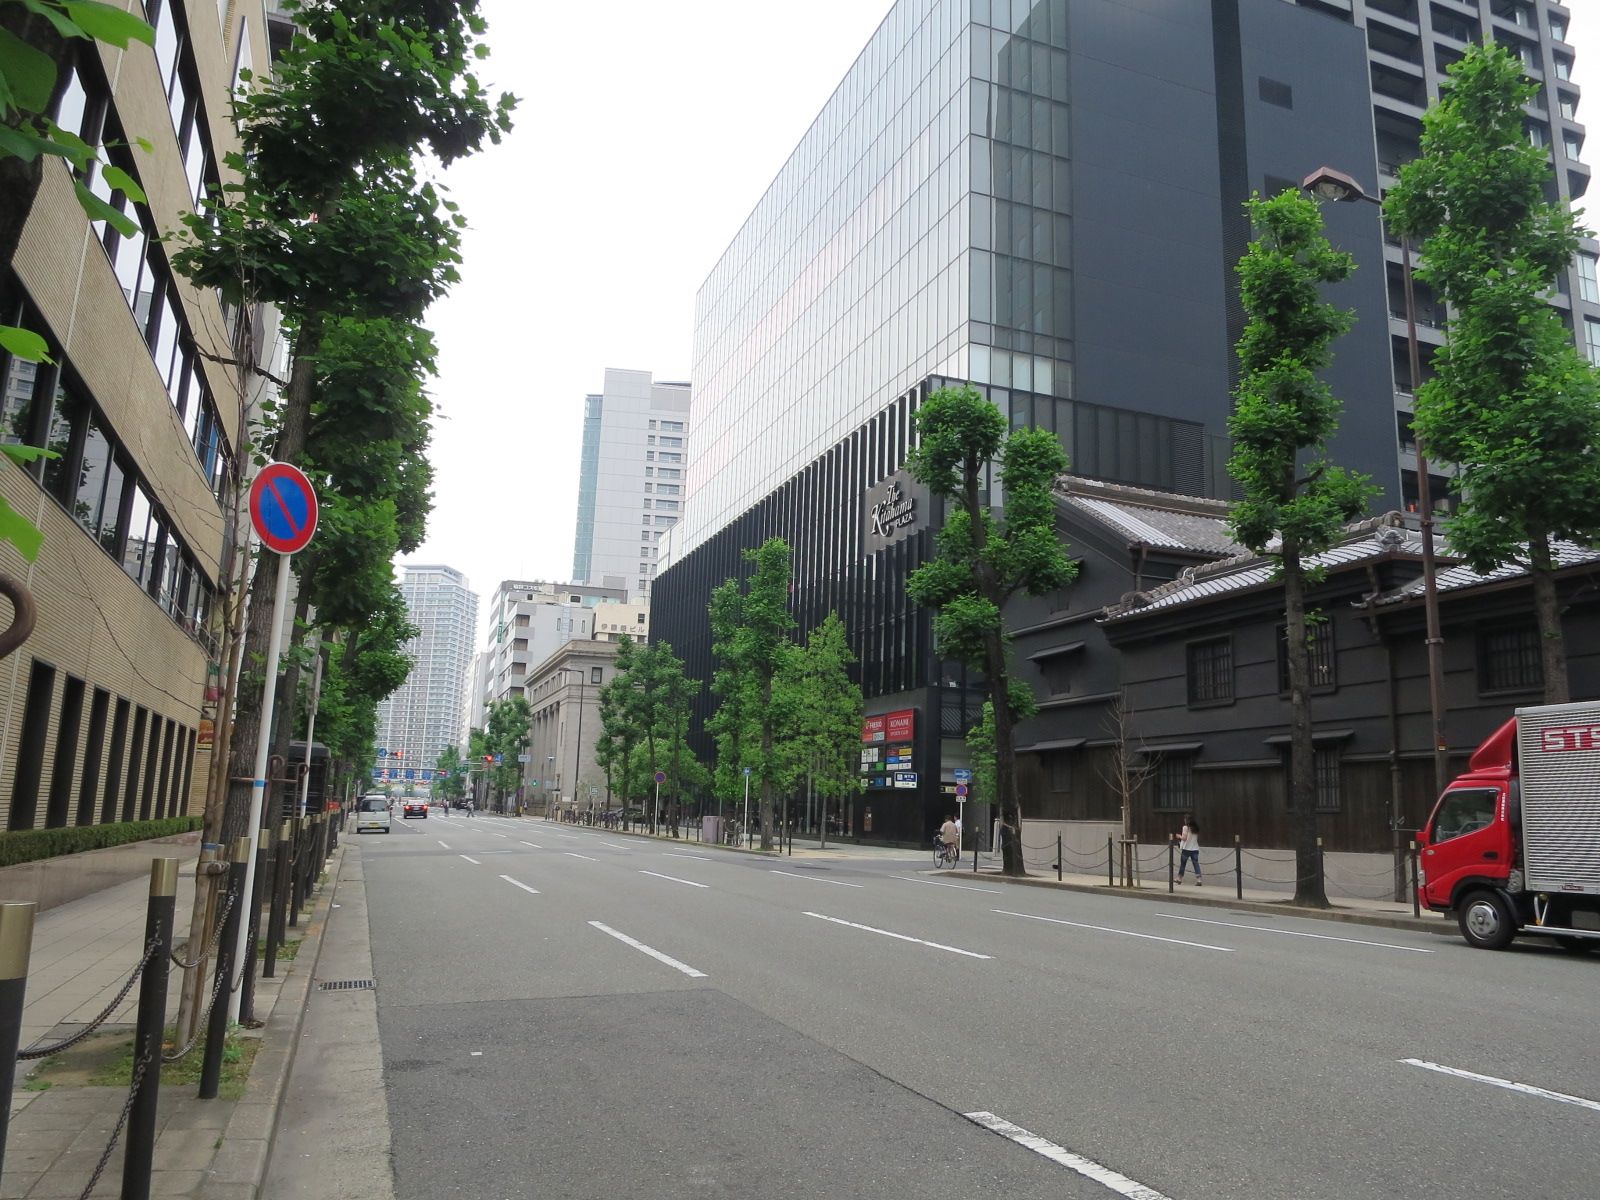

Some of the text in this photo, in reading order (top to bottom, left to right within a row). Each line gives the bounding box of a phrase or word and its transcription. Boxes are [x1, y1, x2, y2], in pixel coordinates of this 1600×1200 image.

[887, 481, 900, 505] The
[871, 498, 913, 537] Kitahama
[896, 512, 912, 527] PLAZA
